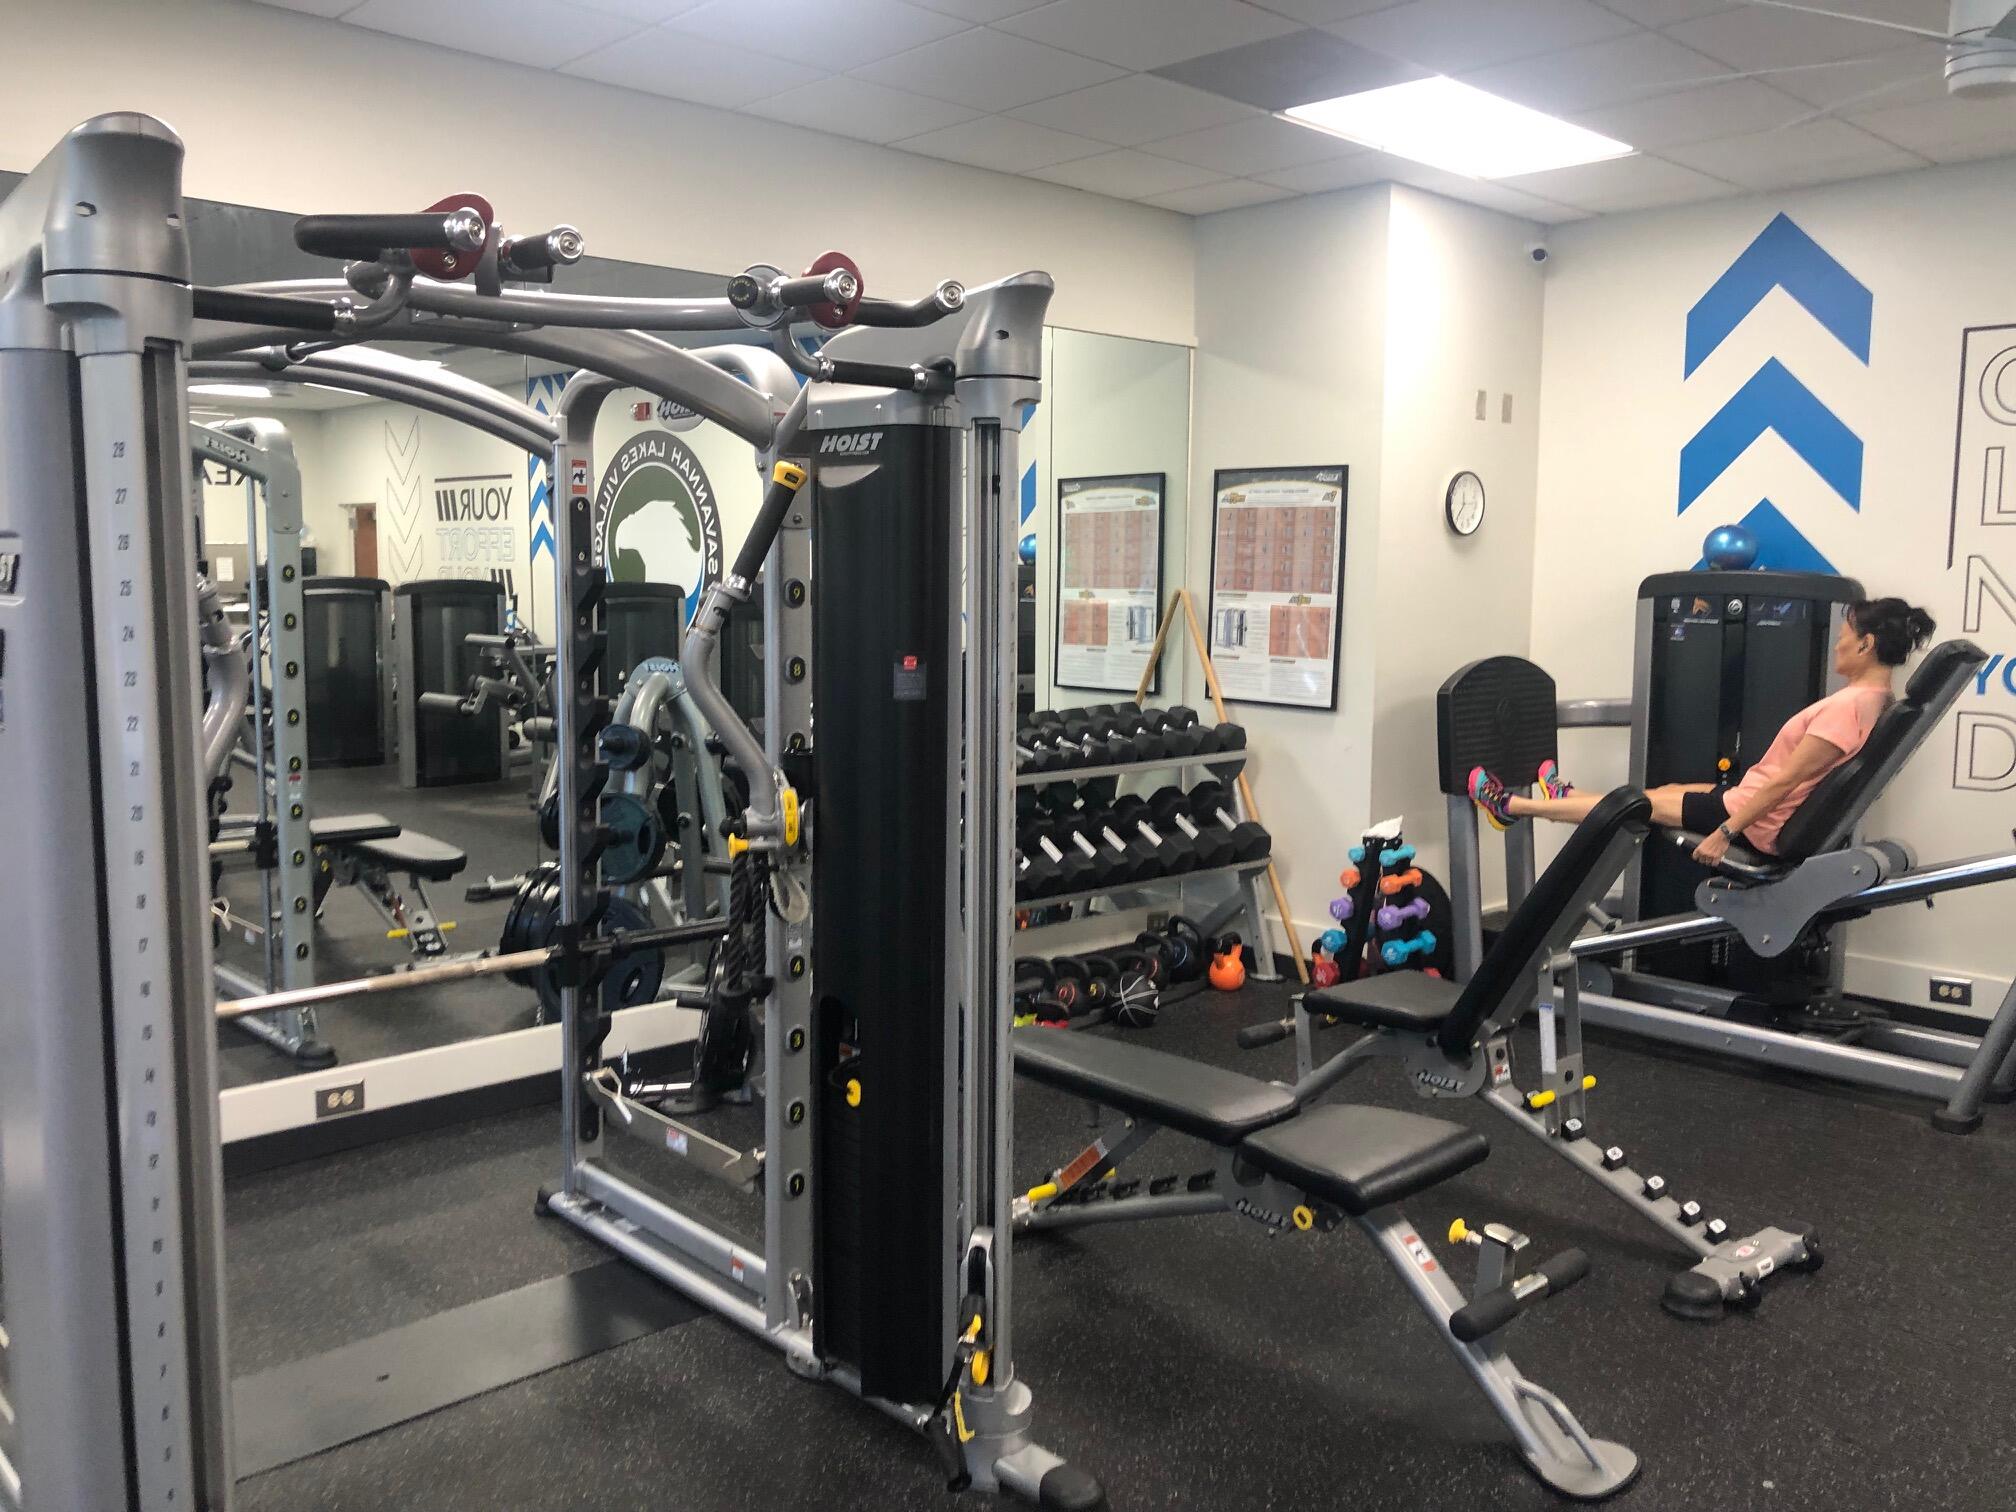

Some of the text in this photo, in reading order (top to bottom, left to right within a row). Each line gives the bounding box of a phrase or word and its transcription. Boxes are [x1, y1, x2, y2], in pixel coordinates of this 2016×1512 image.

[819, 432, 884, 453] HOIST
[115, 488, 127, 504] 27
[126, 716, 139, 732] 22
